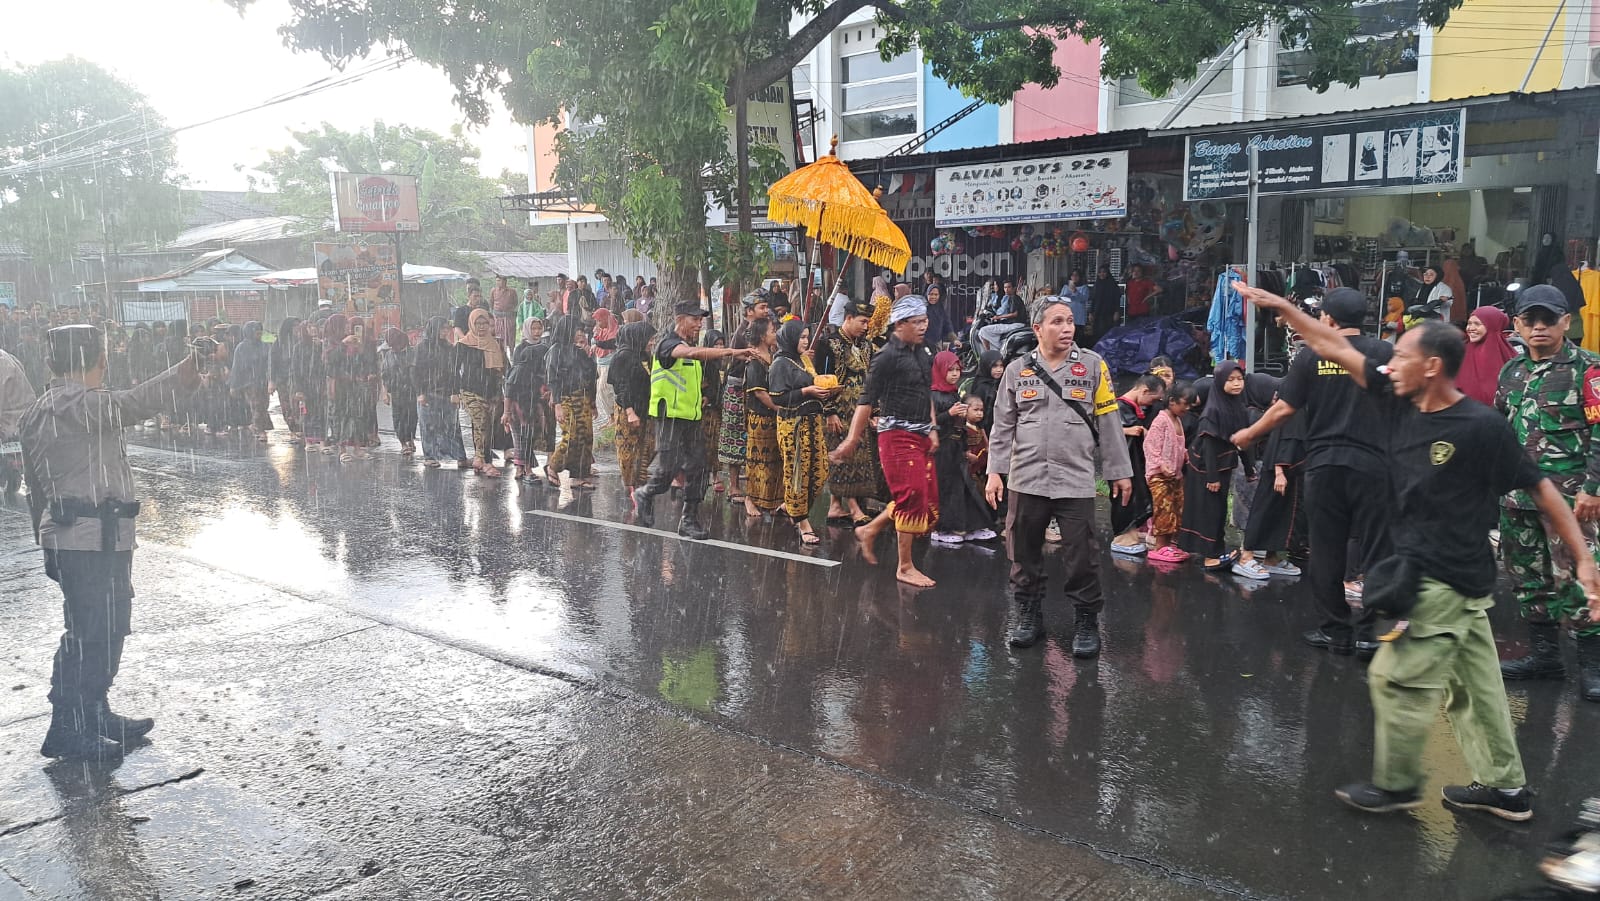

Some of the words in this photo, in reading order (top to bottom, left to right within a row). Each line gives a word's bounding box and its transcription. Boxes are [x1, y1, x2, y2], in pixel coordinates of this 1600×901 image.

[1195, 140, 1241, 160] Bunga
[1246, 134, 1312, 155] Colection
[949, 167, 1004, 182] ALVIN
[1012, 162, 1062, 176] TOYS
[1071, 157, 1113, 171] 924
[1318, 360, 1344, 369] LIN
[1017, 379, 1041, 388] AGUS
[1064, 378, 1091, 387] POLRI
[1584, 405, 1600, 420] BA
